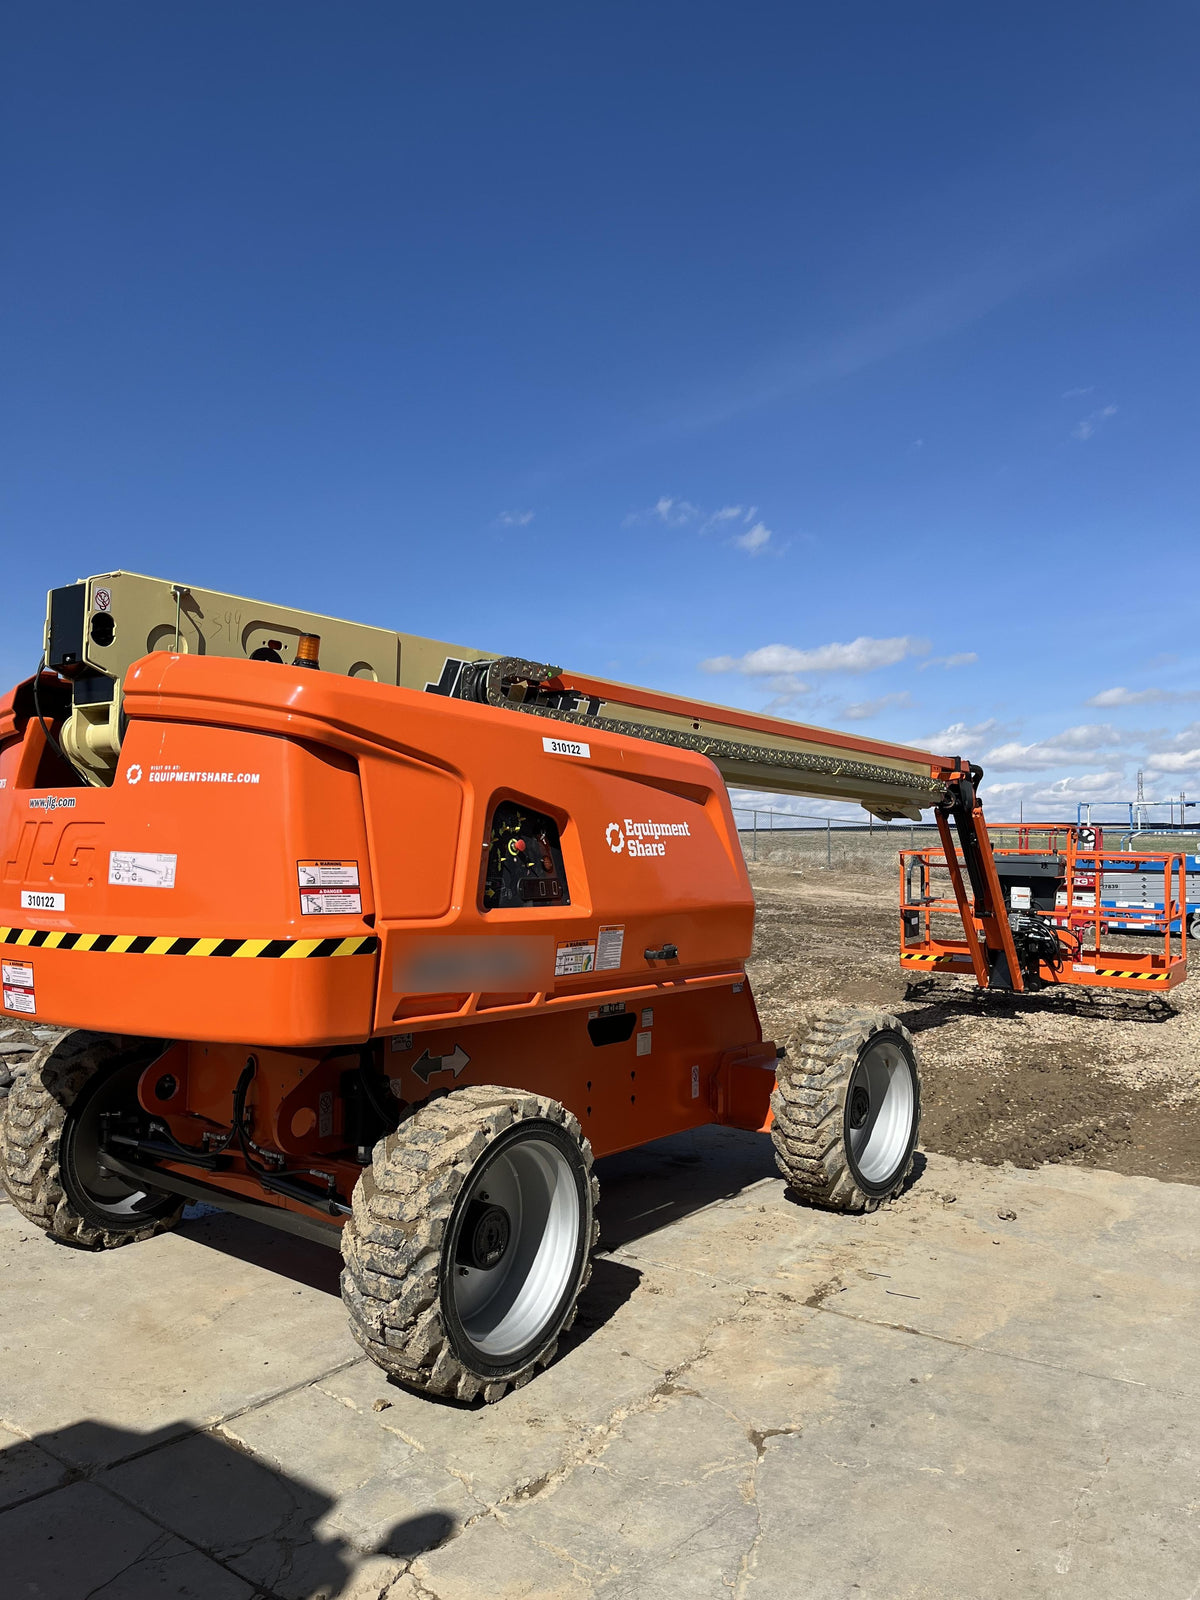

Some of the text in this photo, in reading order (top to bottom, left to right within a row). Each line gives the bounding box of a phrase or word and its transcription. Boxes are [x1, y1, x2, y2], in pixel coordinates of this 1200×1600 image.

[551, 741, 581, 755] 310122
[149, 772, 260, 784] EQUIPMENTSHARE.COM
[30, 796, 76, 810] www.jlg.com
[623, 819, 691, 840] Equipment
[3, 822, 105, 888] JLG
[627, 840, 666, 857] Share
[27, 895, 55, 908] 310122
